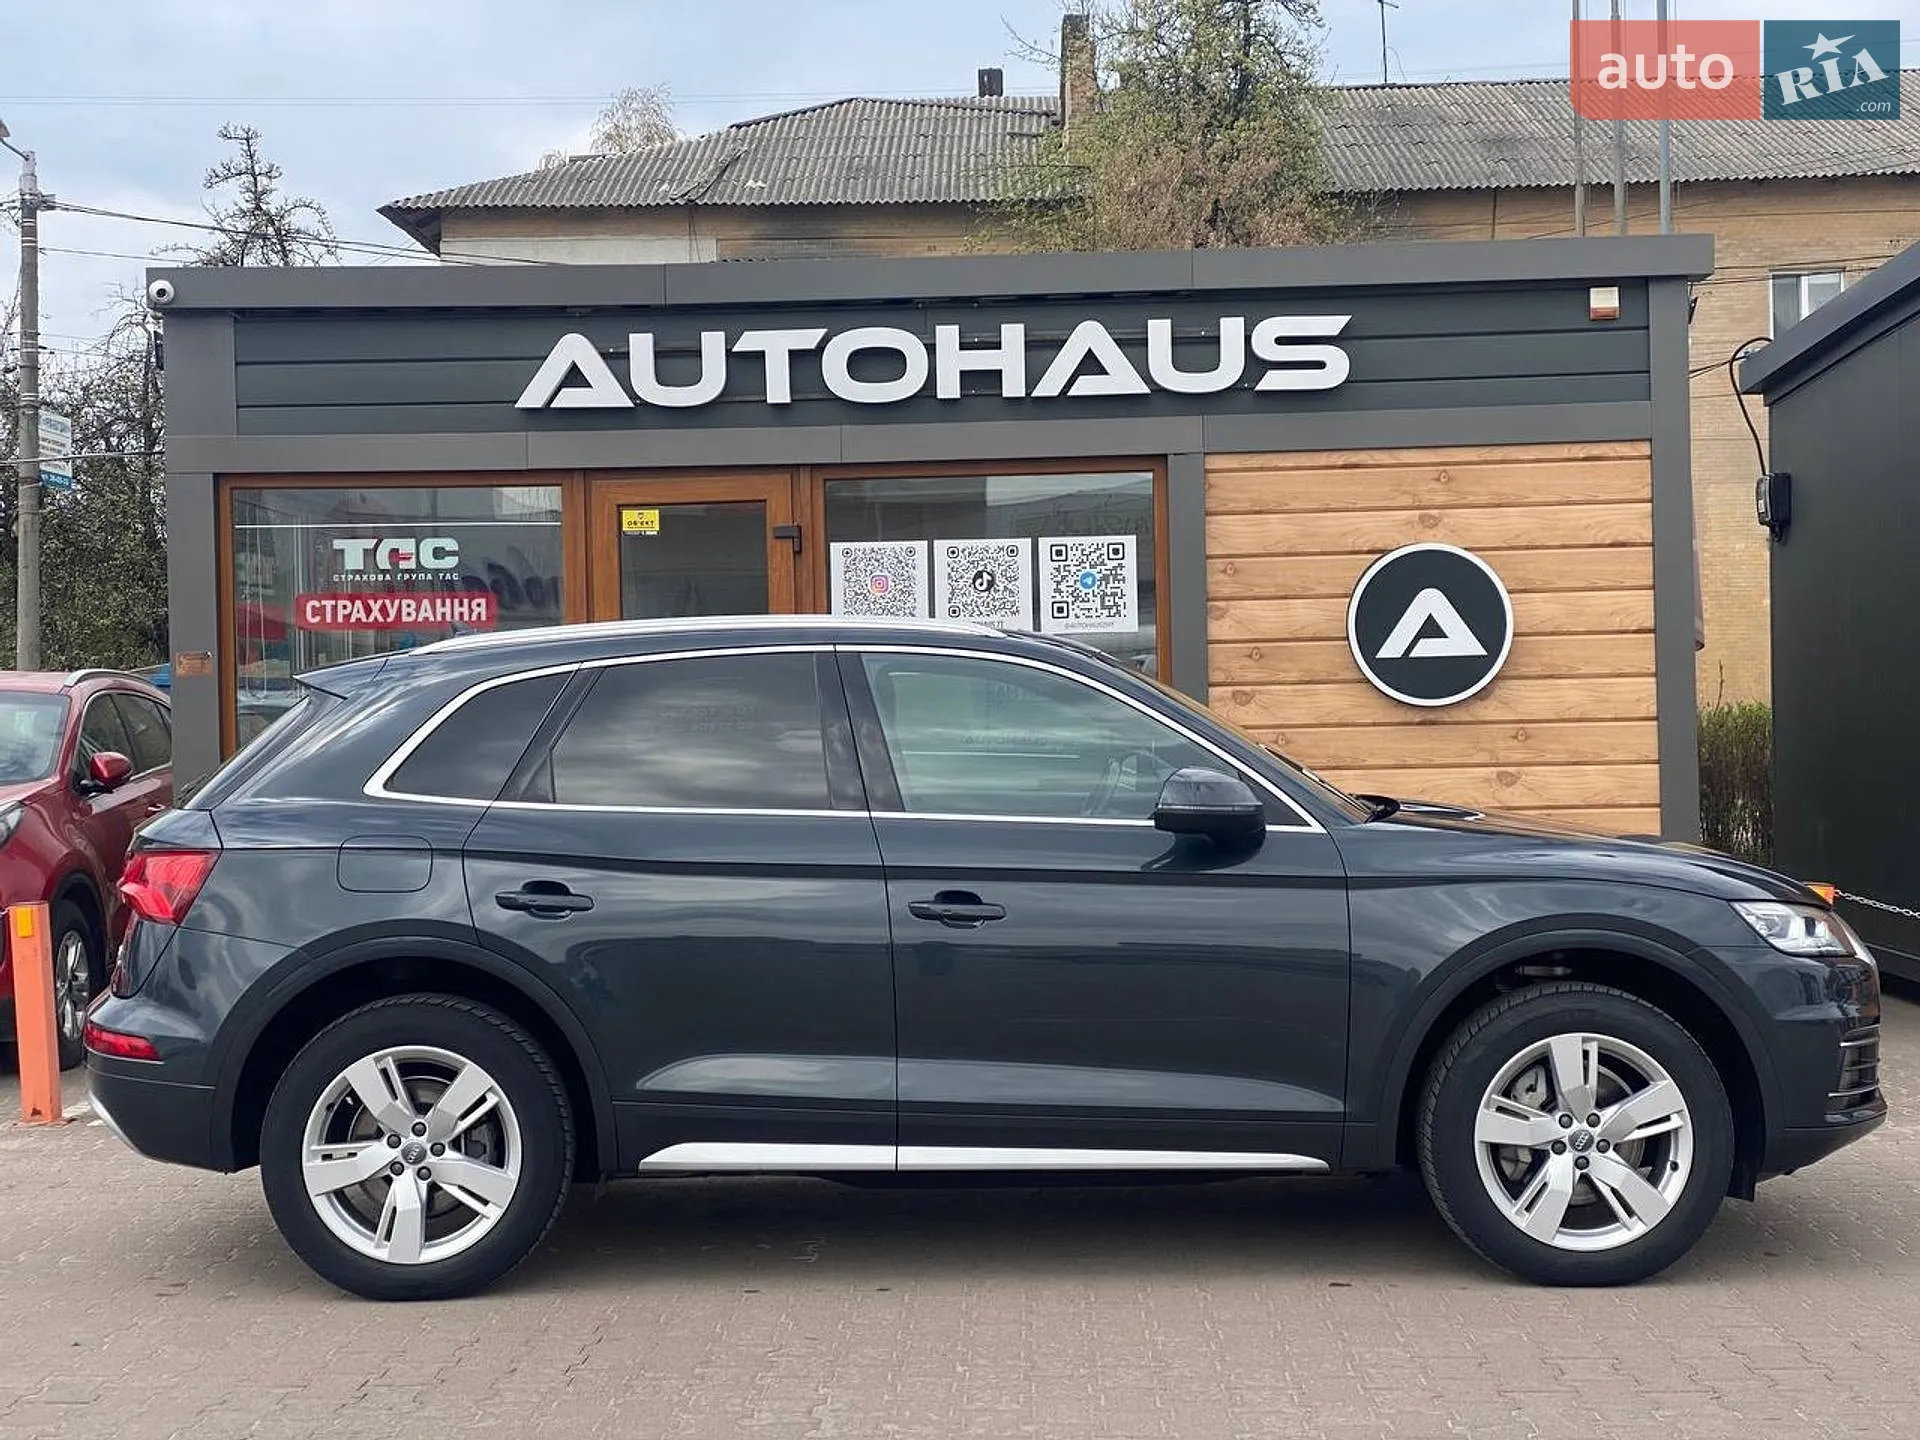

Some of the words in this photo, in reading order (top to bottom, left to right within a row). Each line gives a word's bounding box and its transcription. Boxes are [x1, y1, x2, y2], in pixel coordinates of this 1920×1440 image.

[514, 314, 1353, 410] AUTOHAUS
[332, 537, 460, 570] ТАС
[332, 573, 393, 583] СТРАХОВА
[396, 572, 433, 582] ГРУПА
[437, 572, 460, 581] ТАС
[304, 597, 488, 625] СТРАХУВАННЯ
